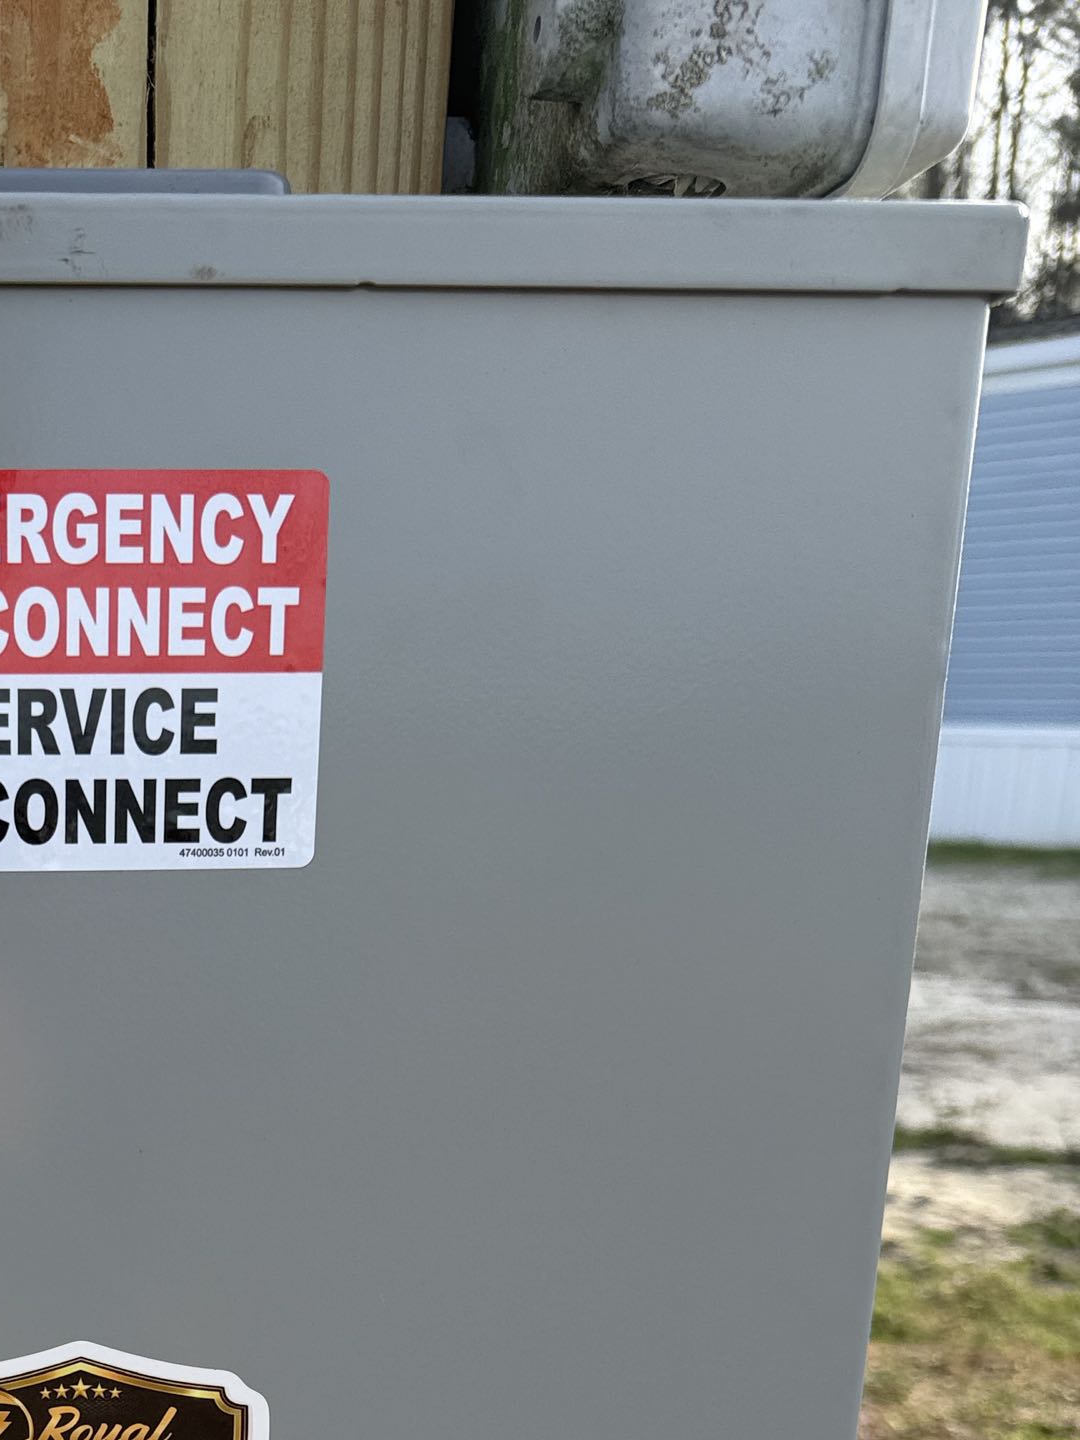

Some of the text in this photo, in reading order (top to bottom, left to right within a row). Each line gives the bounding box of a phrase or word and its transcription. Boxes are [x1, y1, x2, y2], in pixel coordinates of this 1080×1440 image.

[179, 847, 285, 857] 47400035 0101 Rev.01
